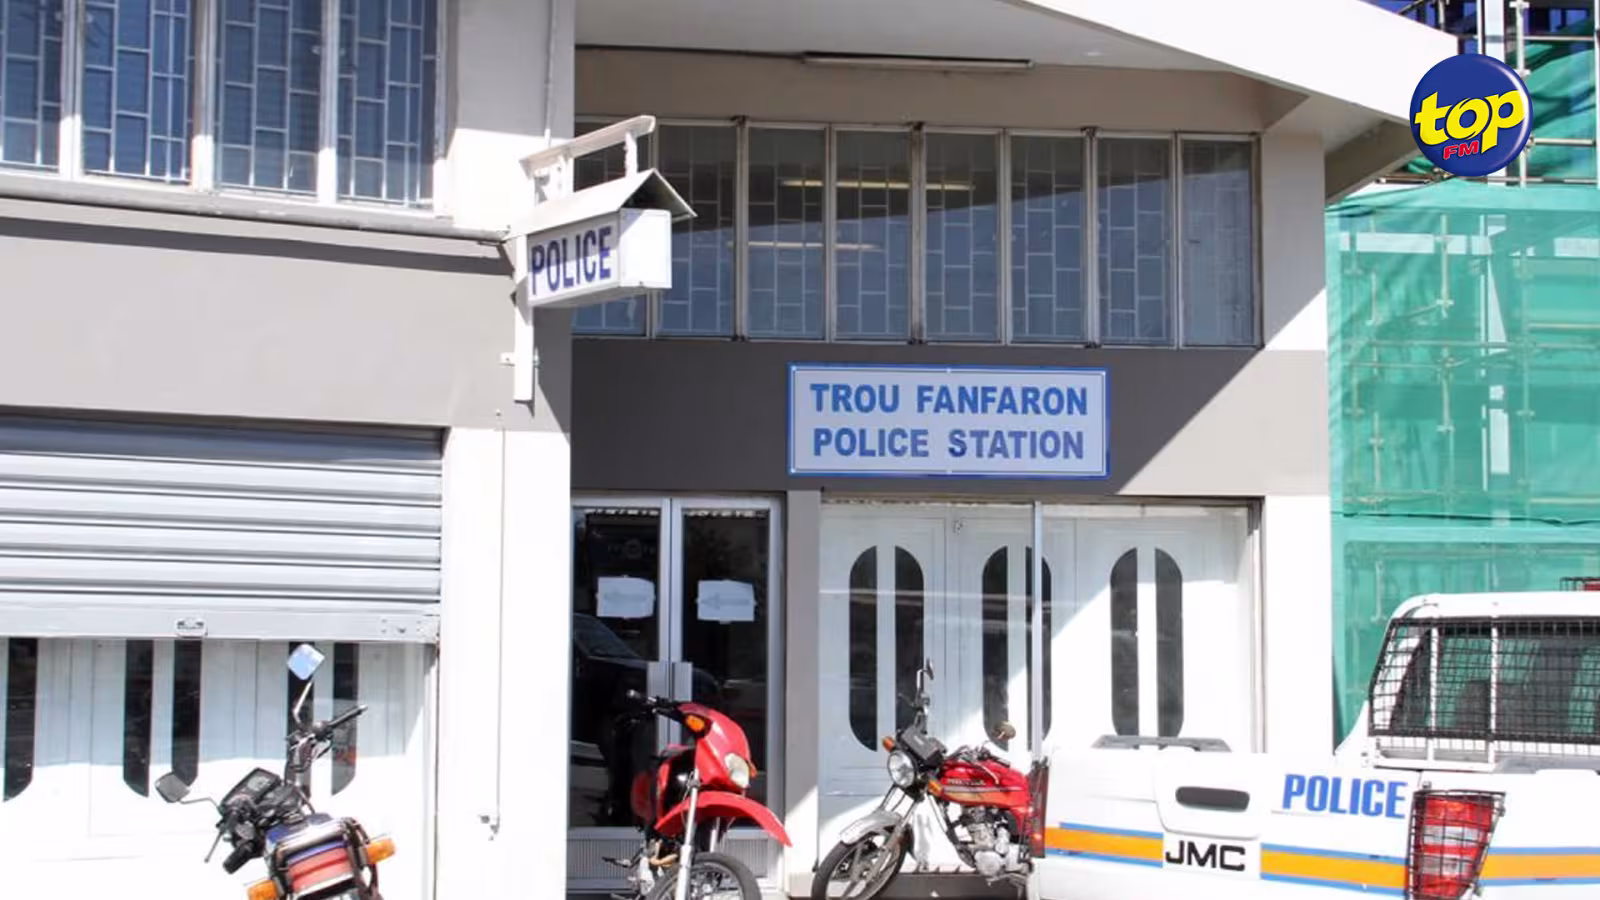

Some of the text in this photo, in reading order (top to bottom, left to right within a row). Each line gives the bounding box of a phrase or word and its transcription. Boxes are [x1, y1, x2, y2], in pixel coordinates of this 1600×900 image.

[531, 225, 612, 295] POLICE
[810, 383, 1088, 415] TROU FANFARON
[813, 427, 1084, 459] POLICE STATION
[1282, 774, 1409, 819] POLICE
[1165, 840, 1246, 871] JMC
